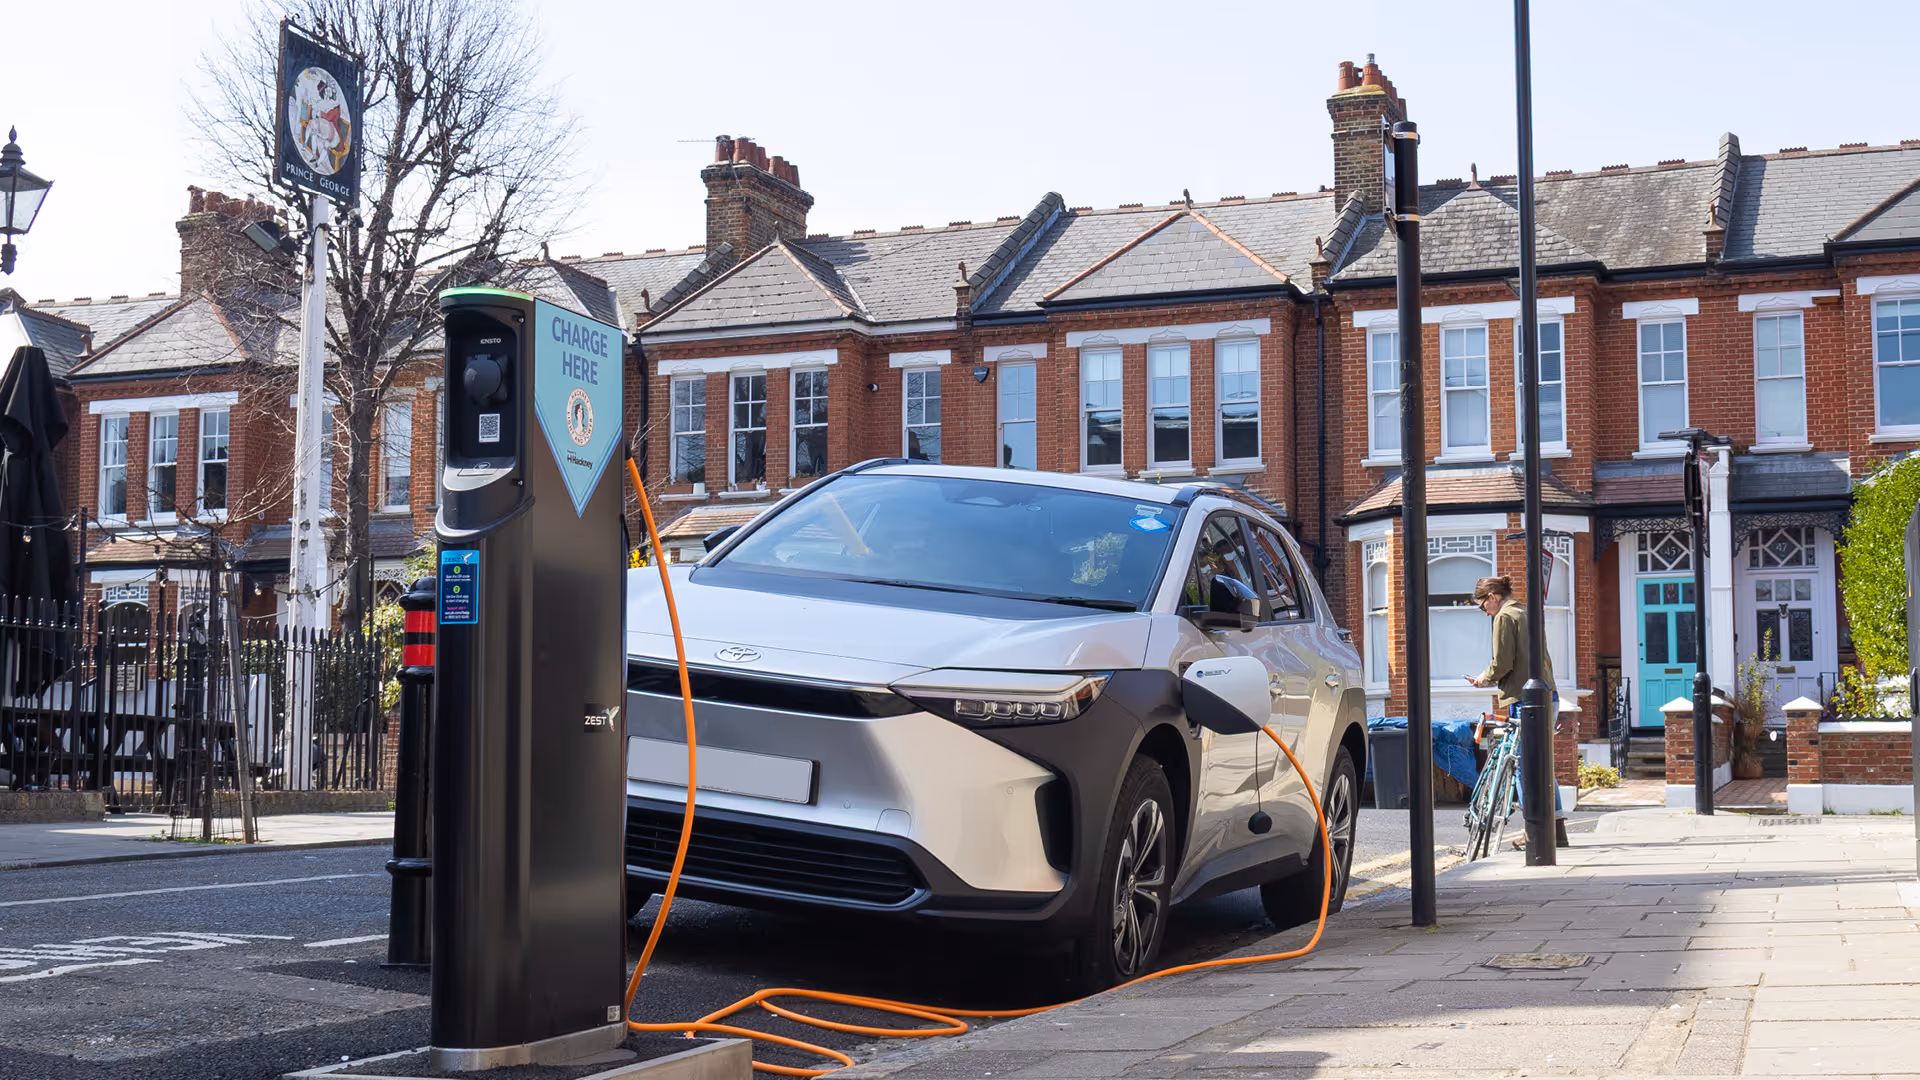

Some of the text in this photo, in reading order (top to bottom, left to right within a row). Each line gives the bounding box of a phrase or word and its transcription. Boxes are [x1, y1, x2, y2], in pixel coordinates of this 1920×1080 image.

[286, 162, 350, 197] PRINCE GEORGE
[552, 316, 608, 358] CHARGE
[563, 351, 598, 385] HERE
[1665, 546, 1676, 556] 45
[1775, 542, 1788, 552] 47
[584, 716, 607, 725] ZEST
